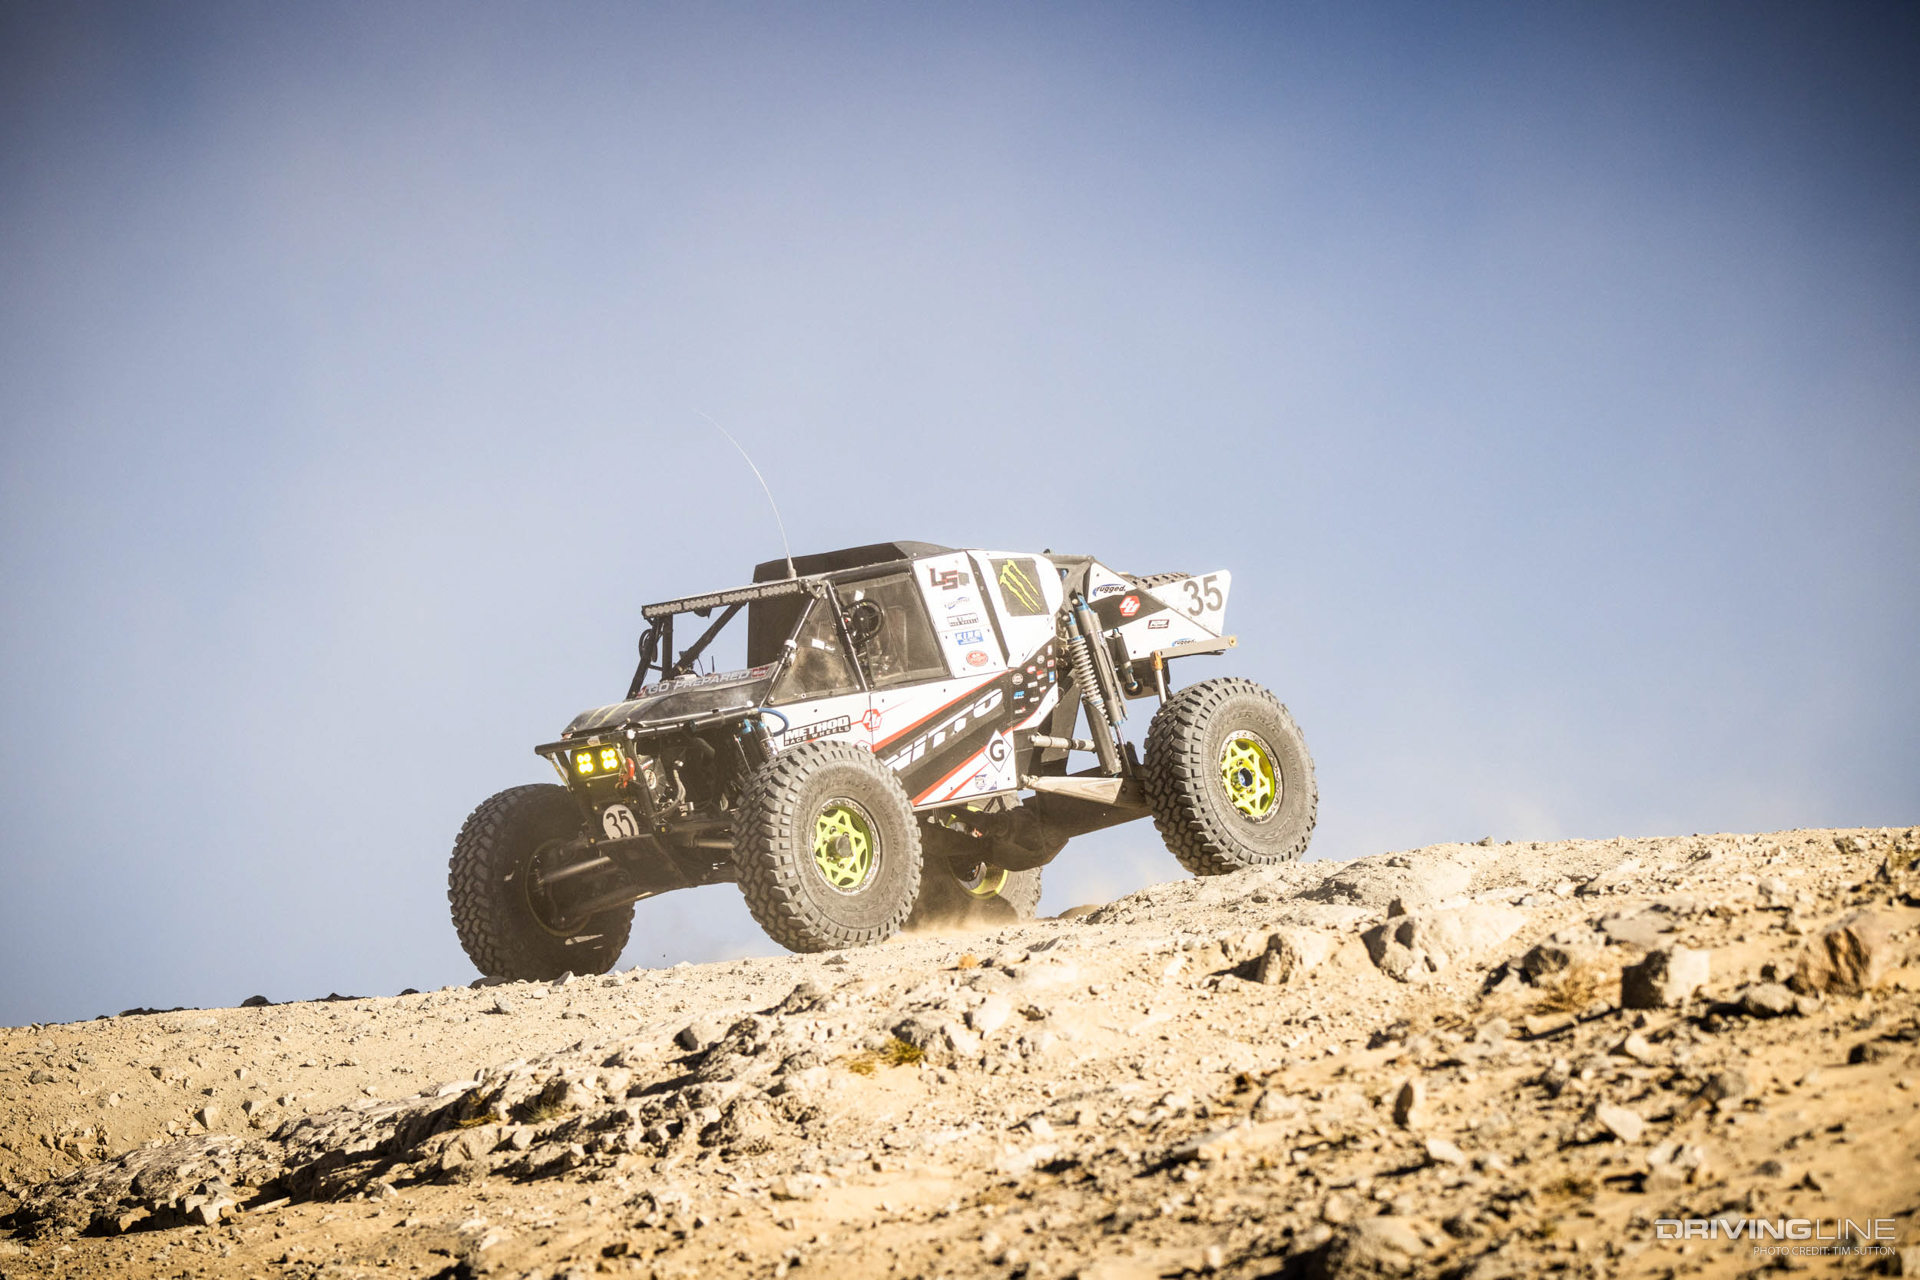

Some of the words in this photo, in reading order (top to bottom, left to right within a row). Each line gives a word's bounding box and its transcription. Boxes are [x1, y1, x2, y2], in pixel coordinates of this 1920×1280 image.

[1183, 574, 1223, 617] 35
[648, 682, 670, 695] GO
[674, 670, 750, 690] PREPARED
[784, 715, 850, 740] METHOD
[784, 735, 808, 746] RACE
[811, 725, 850, 739] WHEELS
[988, 739, 1006, 762] G
[606, 809, 635, 840] 35
